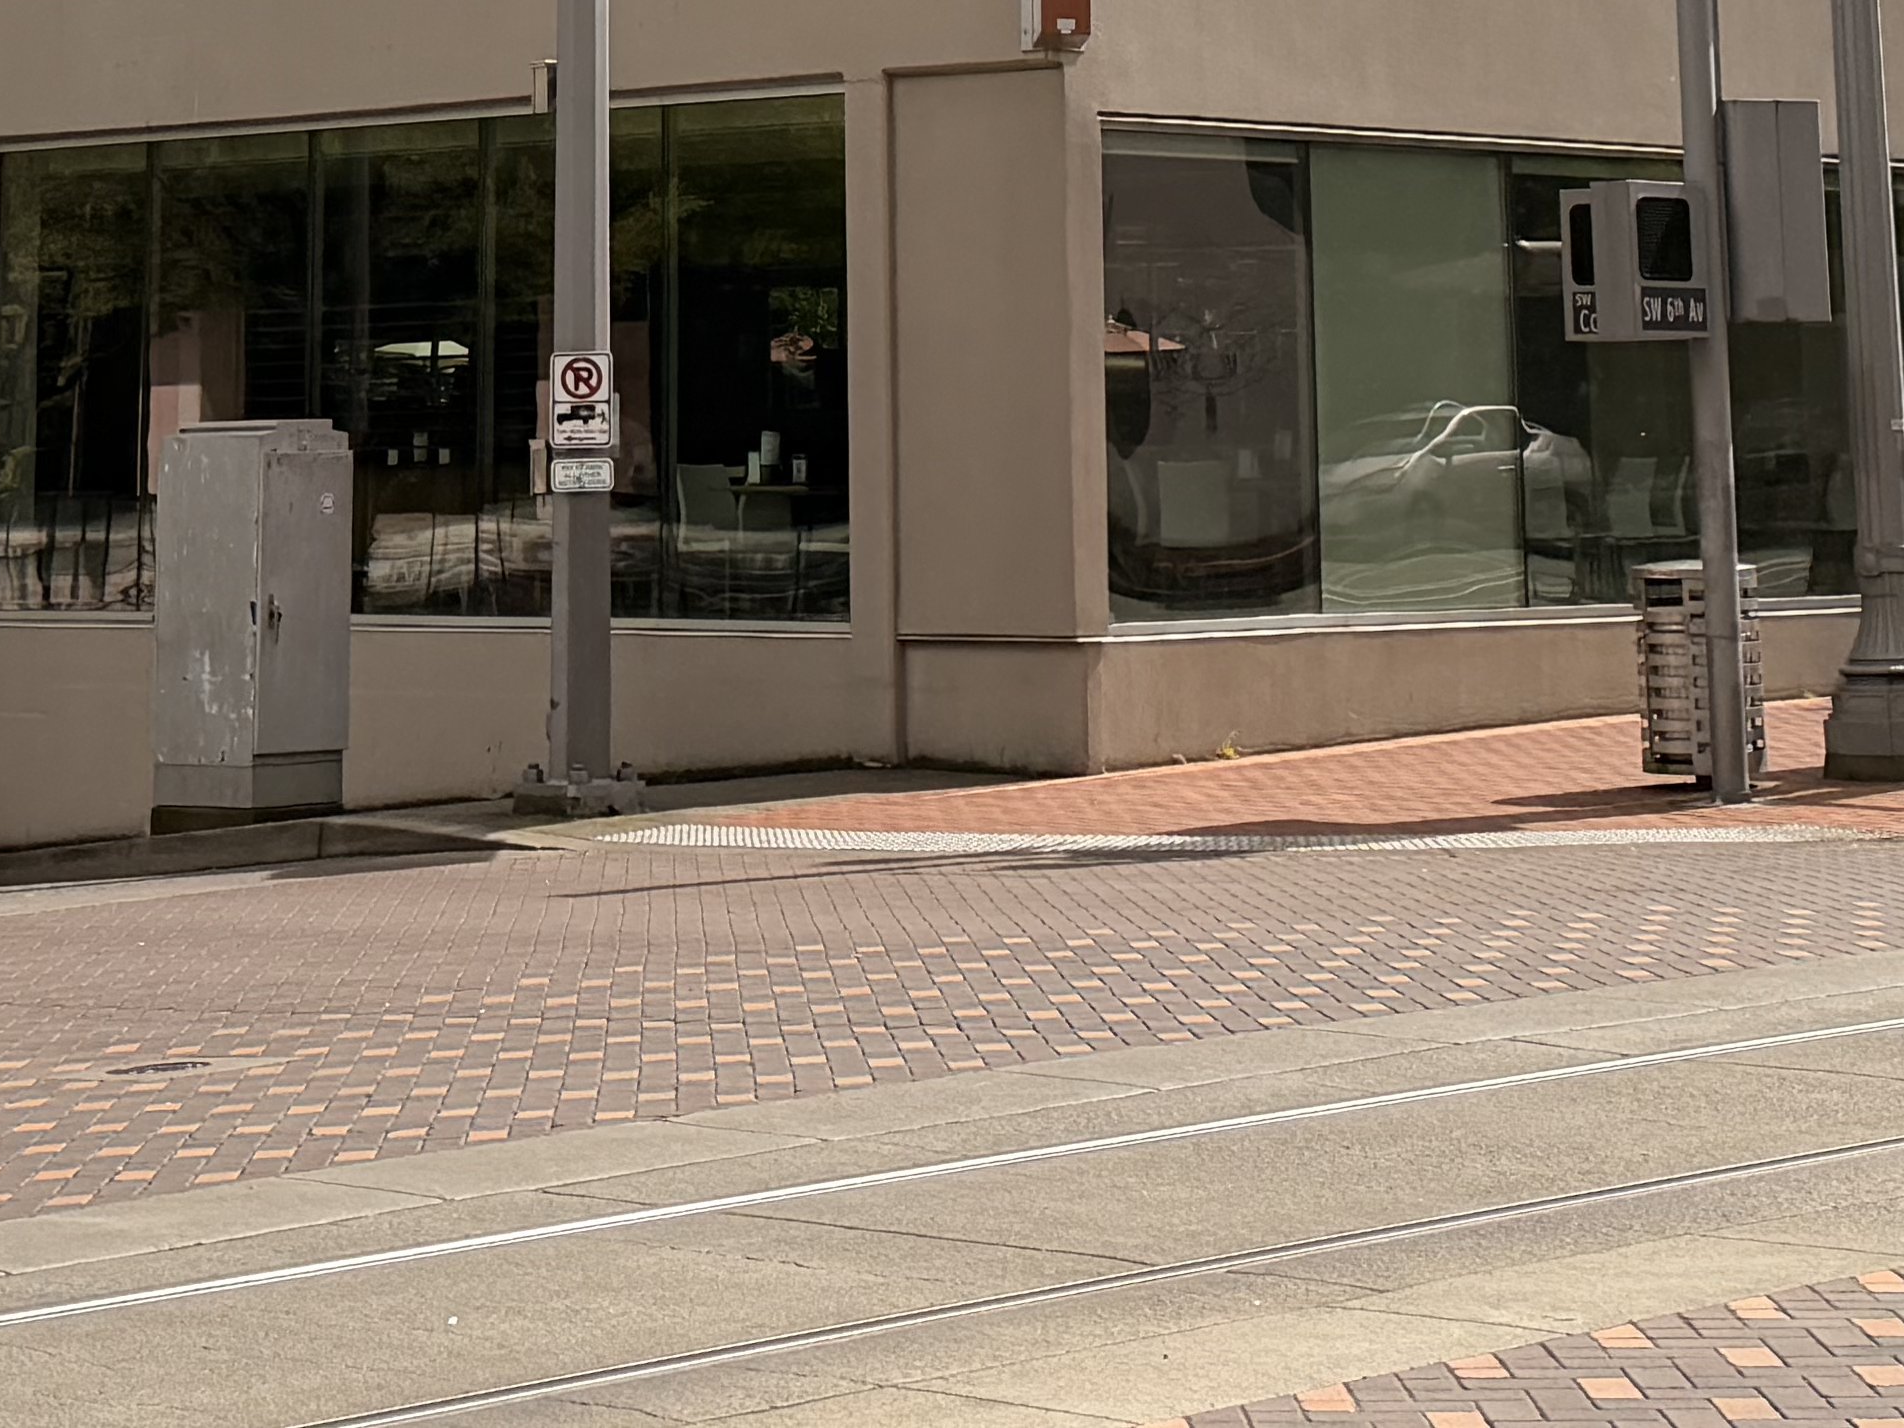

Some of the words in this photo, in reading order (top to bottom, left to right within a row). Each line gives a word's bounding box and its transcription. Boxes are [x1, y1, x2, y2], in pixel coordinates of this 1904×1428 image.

[1575, 293, 1592, 307] SW
[1643, 297, 1662, 322] SW
[1667, 297, 1684, 322] 6th
